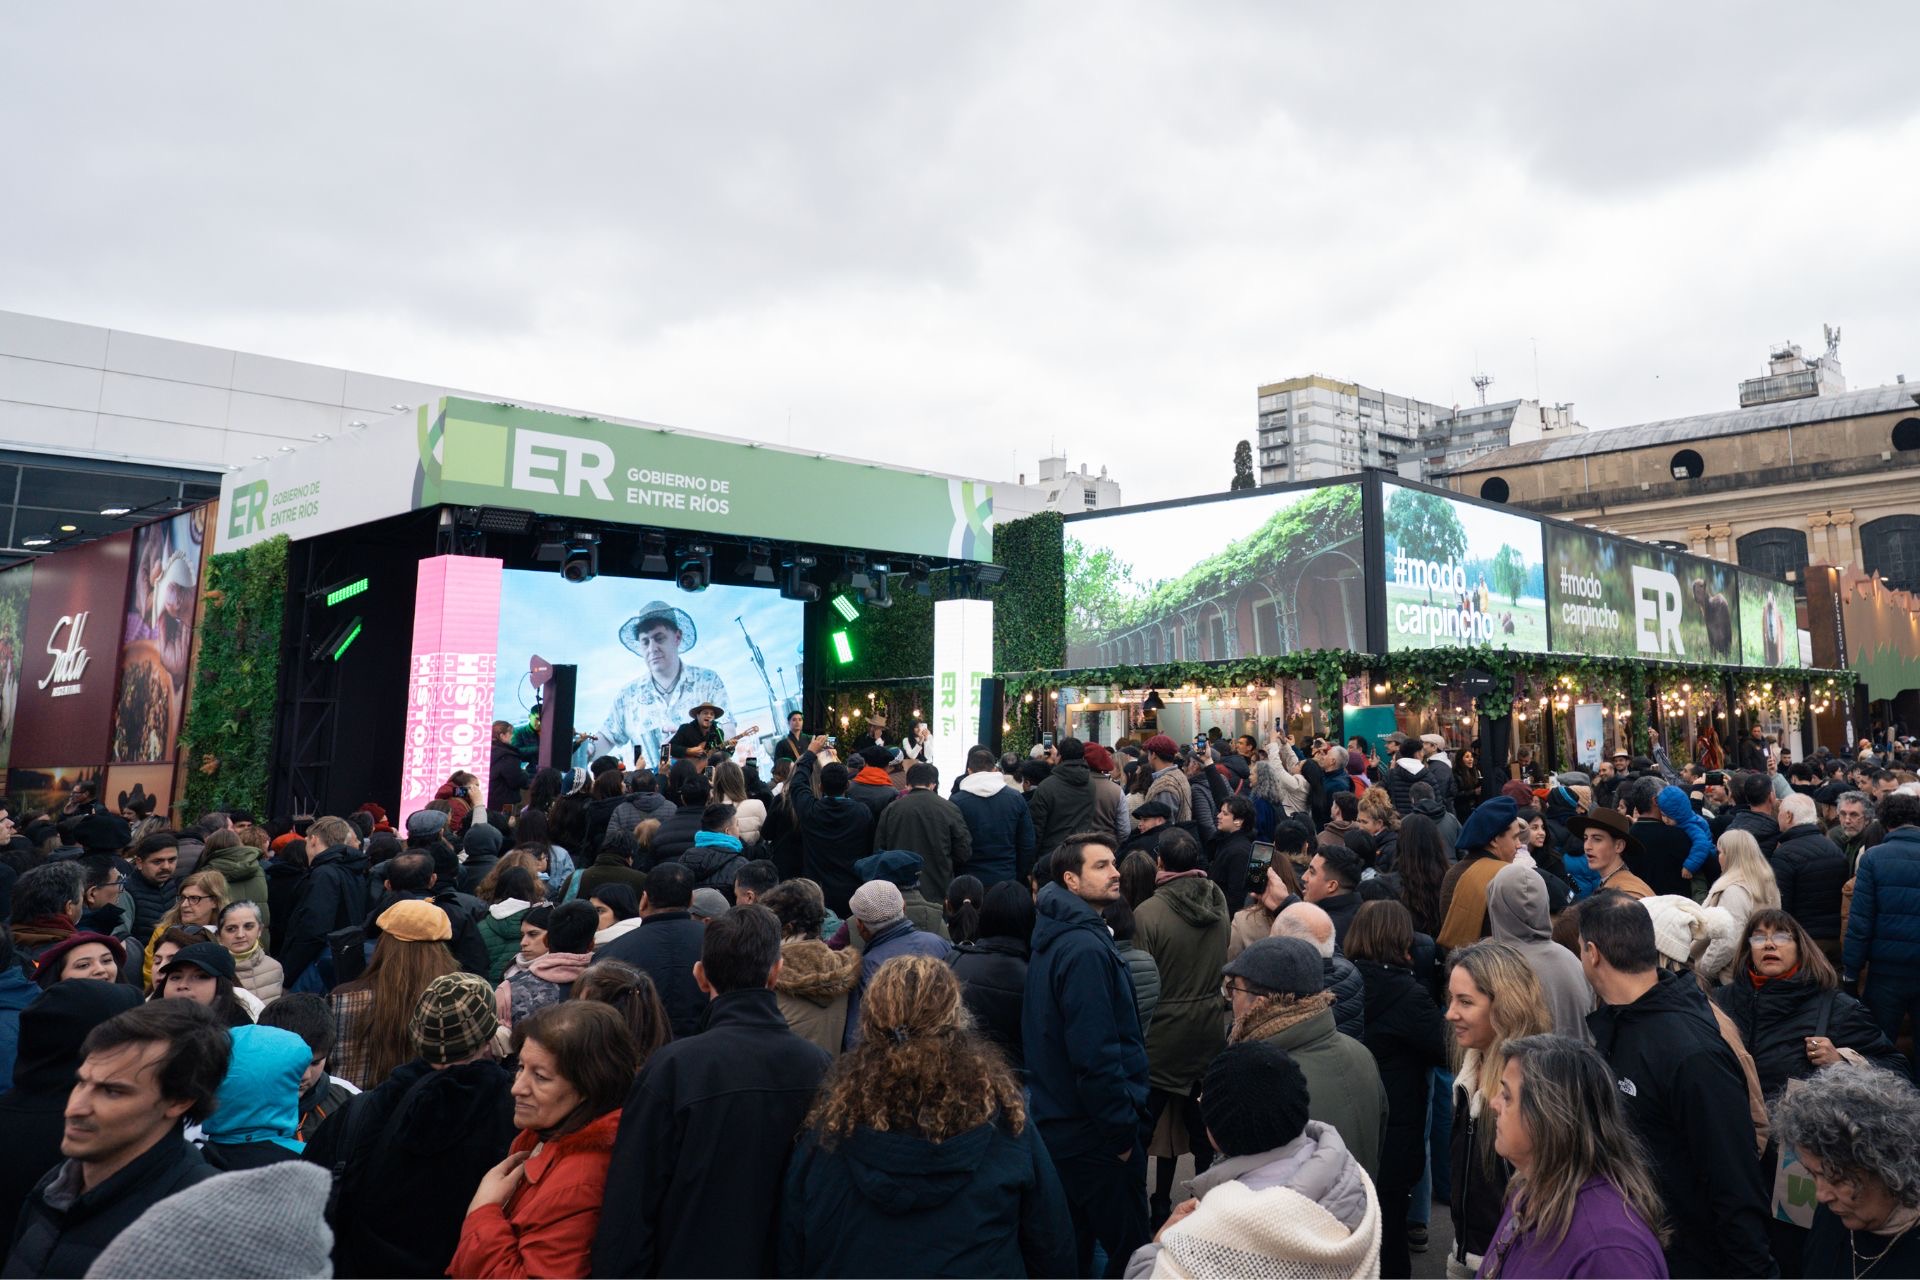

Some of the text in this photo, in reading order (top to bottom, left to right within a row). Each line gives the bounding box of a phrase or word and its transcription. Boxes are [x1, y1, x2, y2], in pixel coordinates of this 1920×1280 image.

[512, 428, 615, 501] ER
[627, 468, 730, 494] GOBIERNO DE
[228, 479, 269, 540] ER
[270, 500, 319, 528] ENTRE RÍOS
[272, 480, 321, 506] GOBIERNO DE
[626, 487, 730, 515] ENTRE RÍOS
[1393, 546, 1466, 595] #modo
[1560, 566, 1602, 600] #modo
[1395, 598, 1494, 648] carpincho
[1562, 600, 1619, 635] carpincho
[1631, 565, 1686, 655] ER
[38, 611, 91, 689] Salta
[941, 671, 956, 708] ER
[410, 655, 431, 801] HISTORIA
[450, 655, 479, 774] HISTORI
